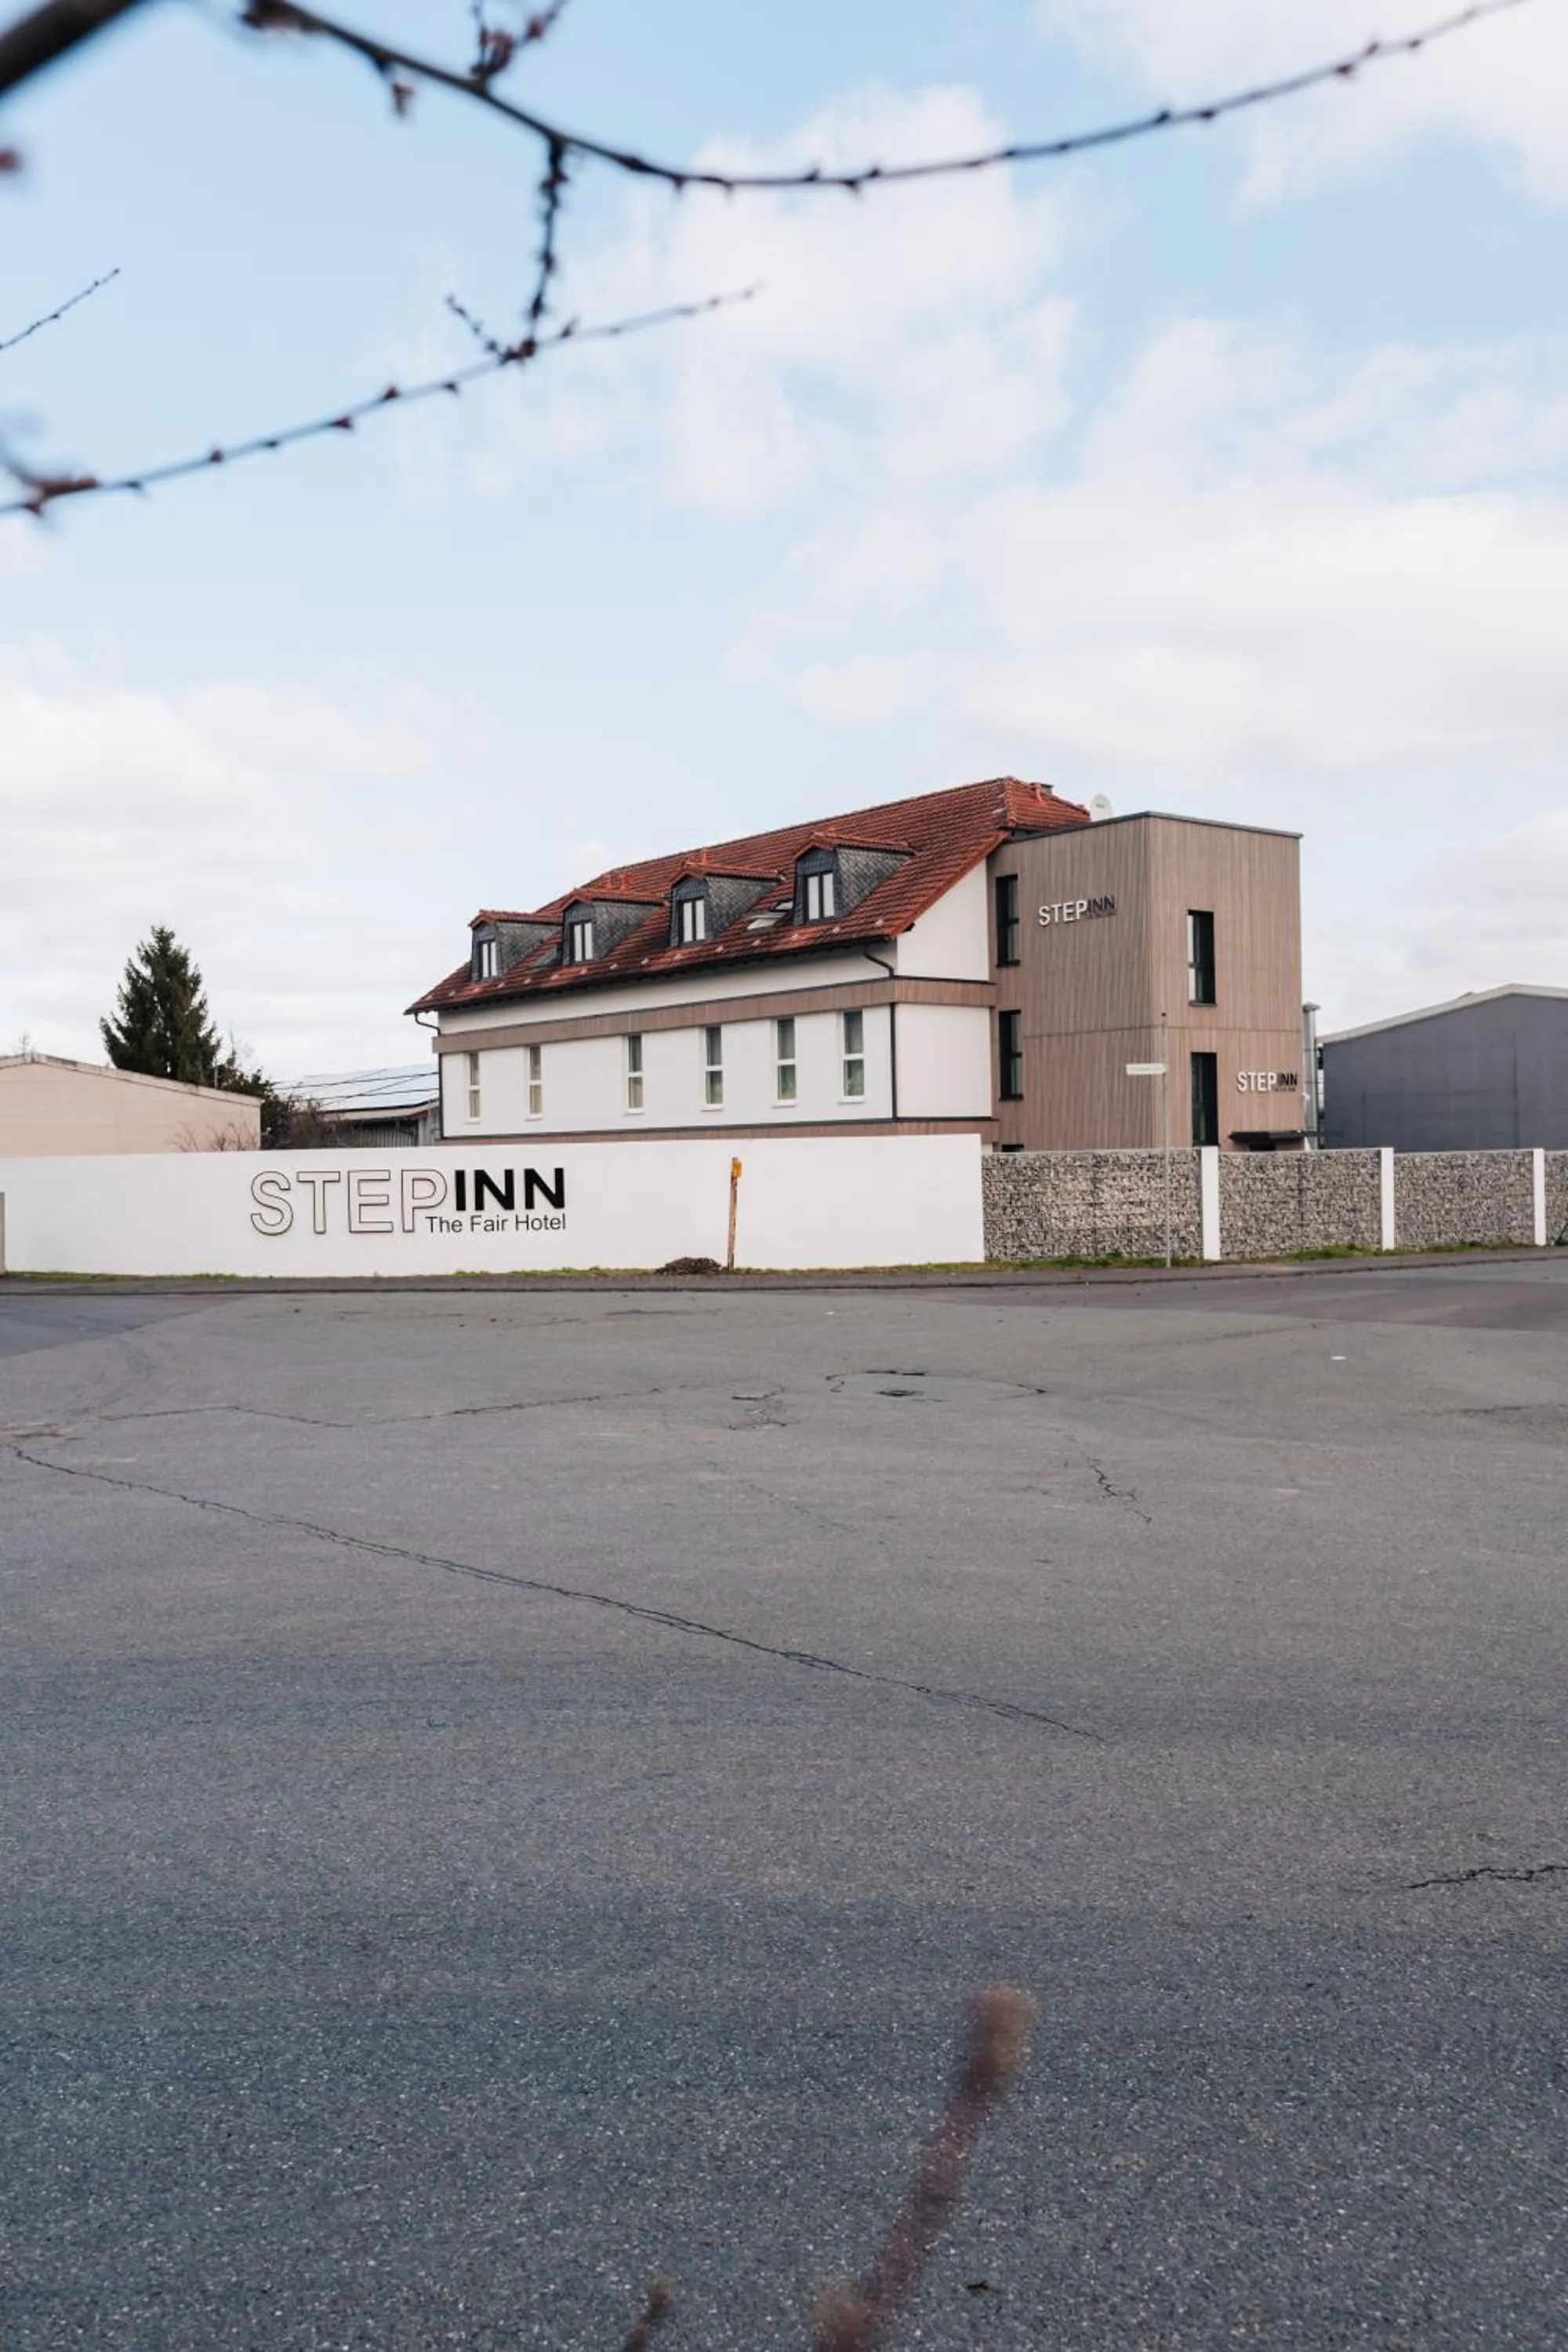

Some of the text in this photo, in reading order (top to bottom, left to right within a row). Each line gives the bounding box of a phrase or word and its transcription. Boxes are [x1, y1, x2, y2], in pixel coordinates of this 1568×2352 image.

[425, 1213, 566, 1233] The Fair Hotel
